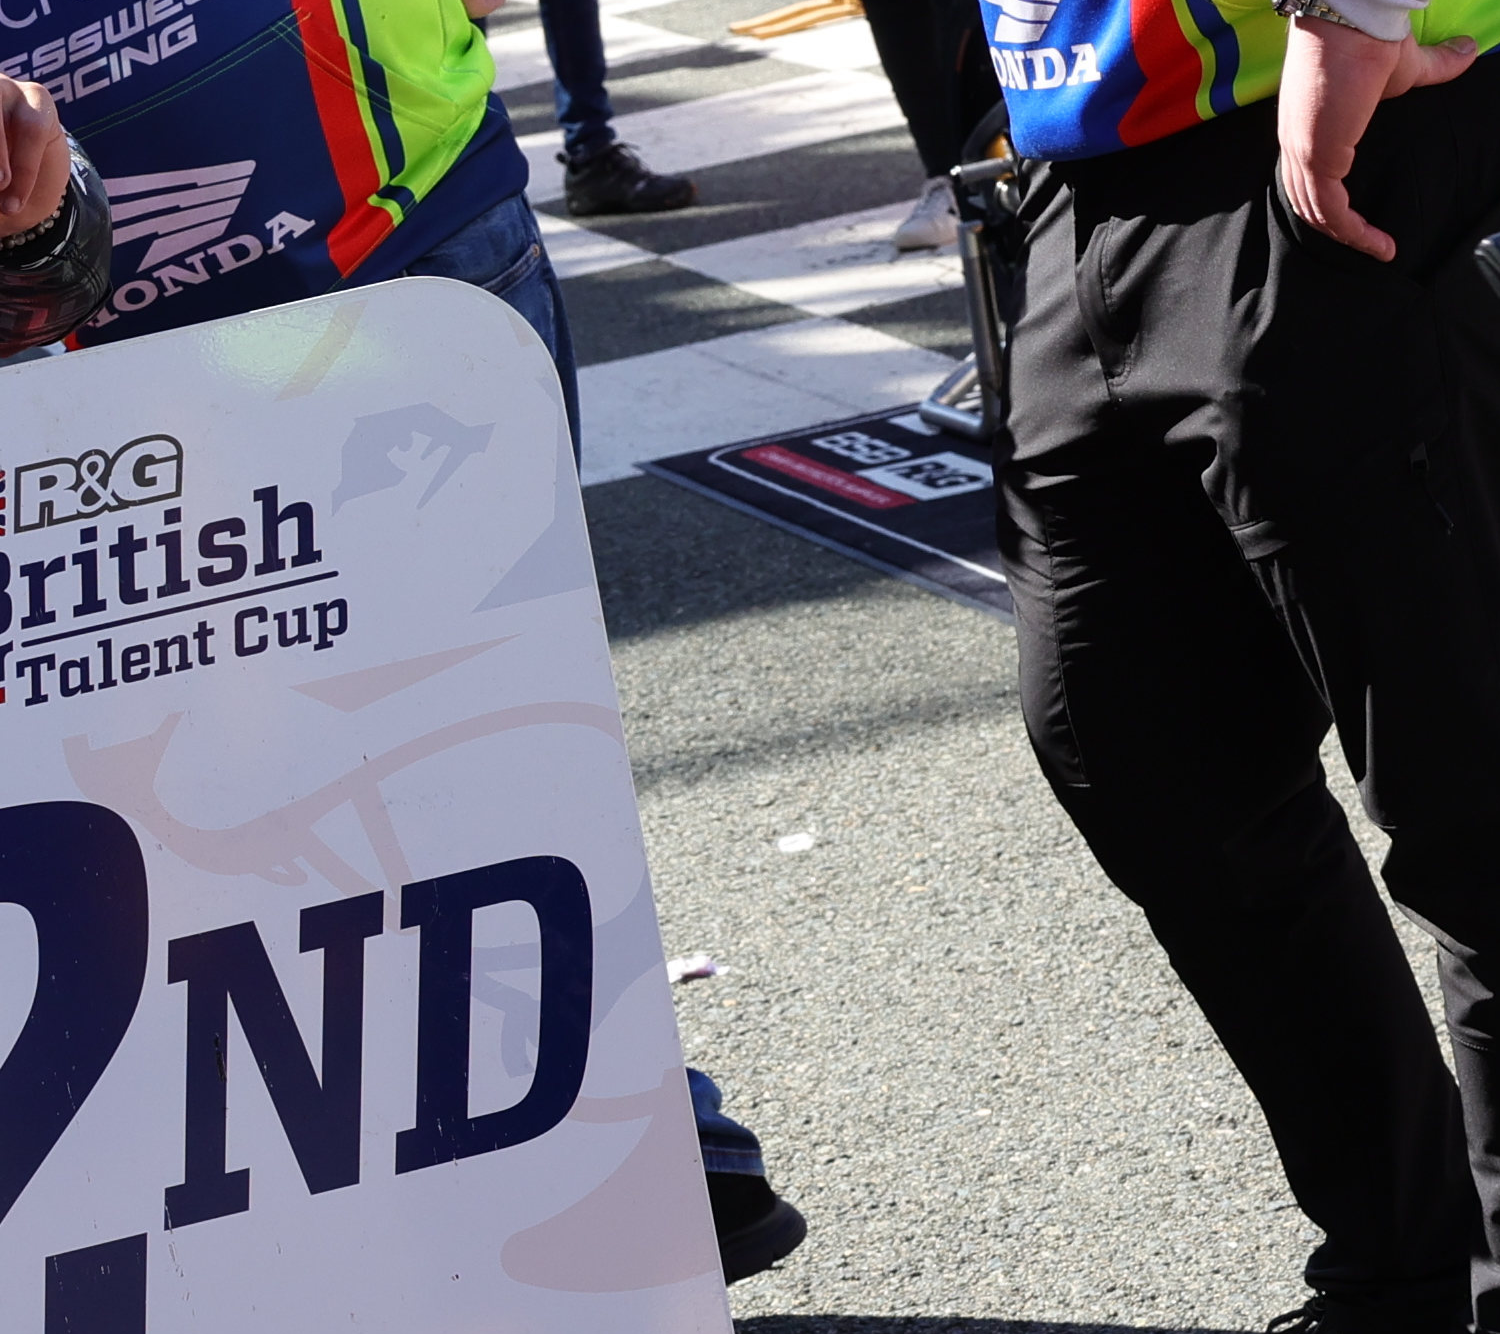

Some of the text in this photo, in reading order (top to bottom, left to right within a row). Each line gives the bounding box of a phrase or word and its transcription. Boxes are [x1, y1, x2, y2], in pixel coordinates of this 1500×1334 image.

[46, 15, 199, 108] ACING
[14, 434, 184, 534] R&G
[16, 592, 350, 708] Talent Cup
